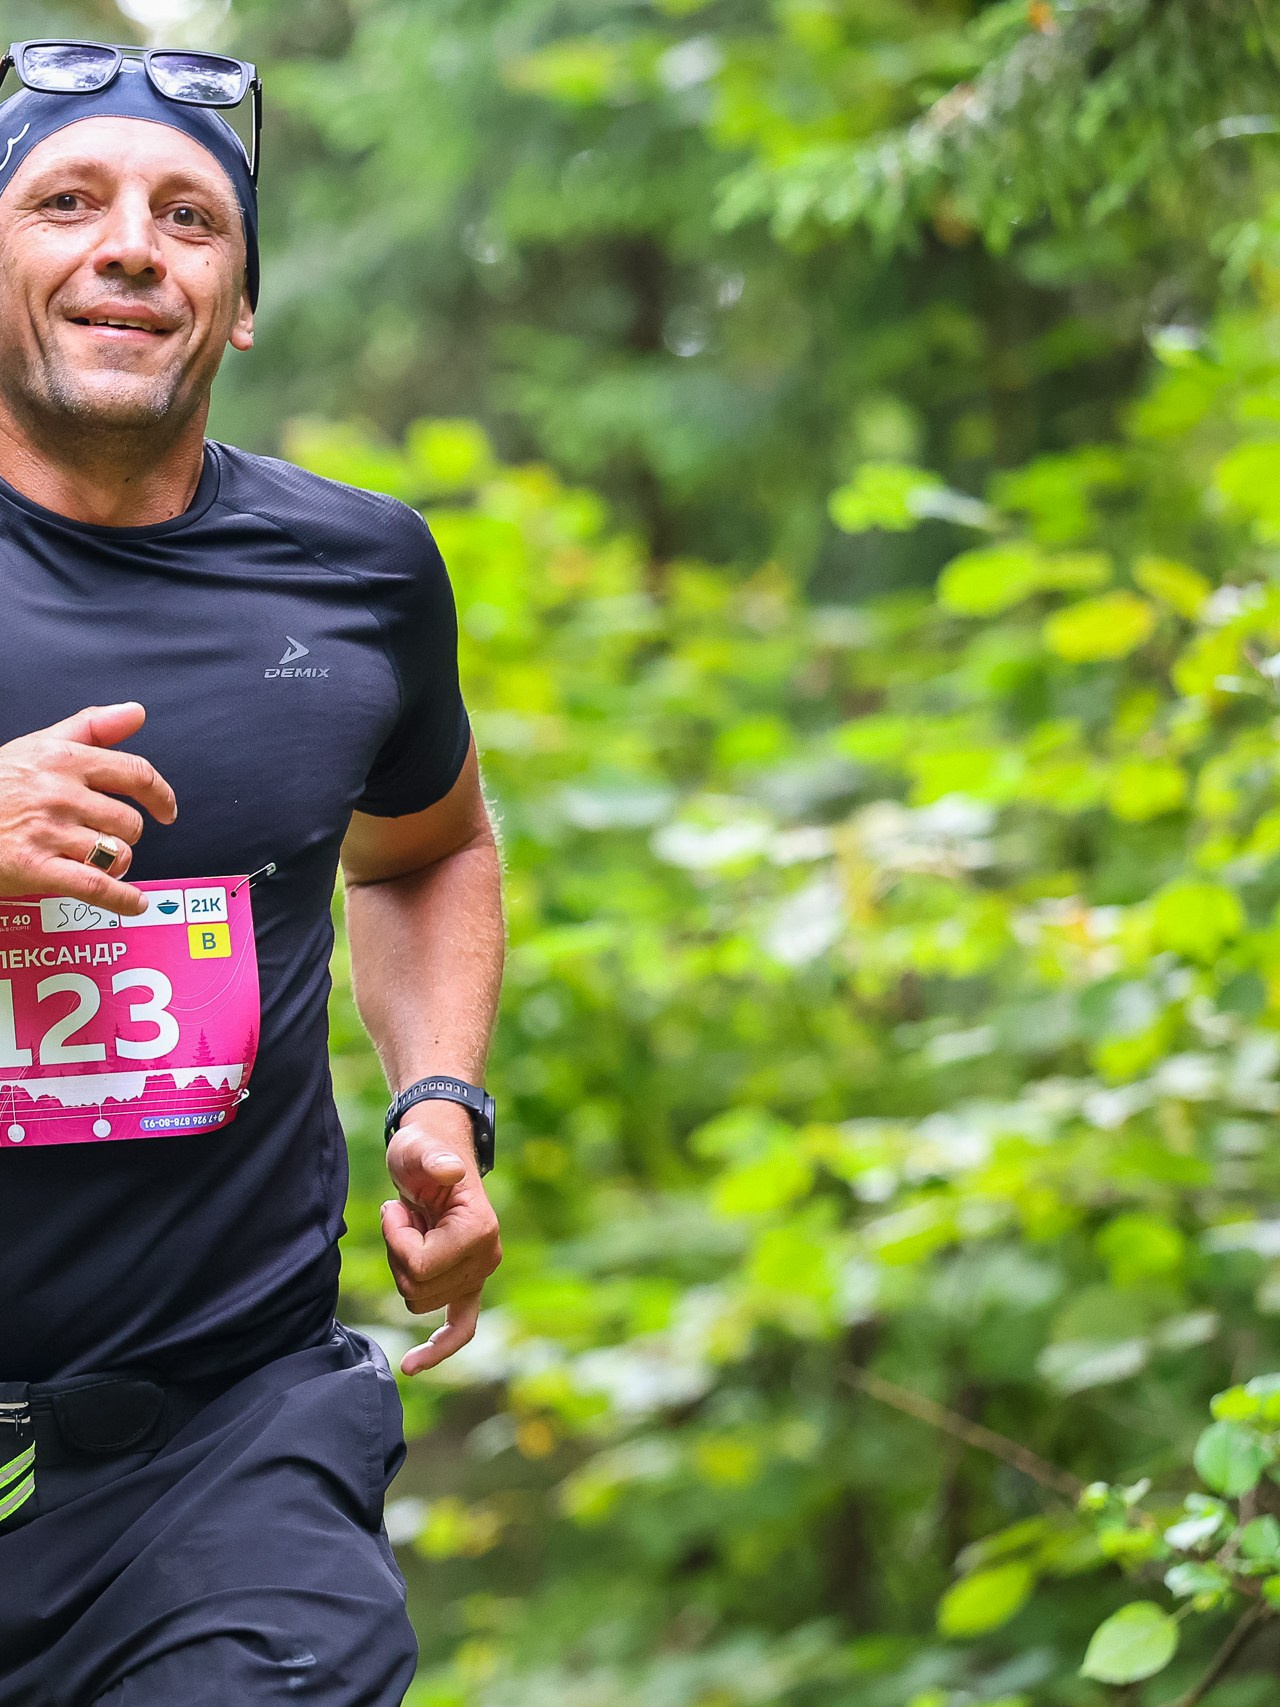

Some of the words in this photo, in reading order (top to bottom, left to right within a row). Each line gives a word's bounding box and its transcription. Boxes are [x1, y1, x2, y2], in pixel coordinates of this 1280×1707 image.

[264, 667, 330, 678] DEMIX
[12, 914, 31, 926] 40
[144, 1117, 190, 1128] 878-80-91
[192, 1115, 206, 1125] 926
